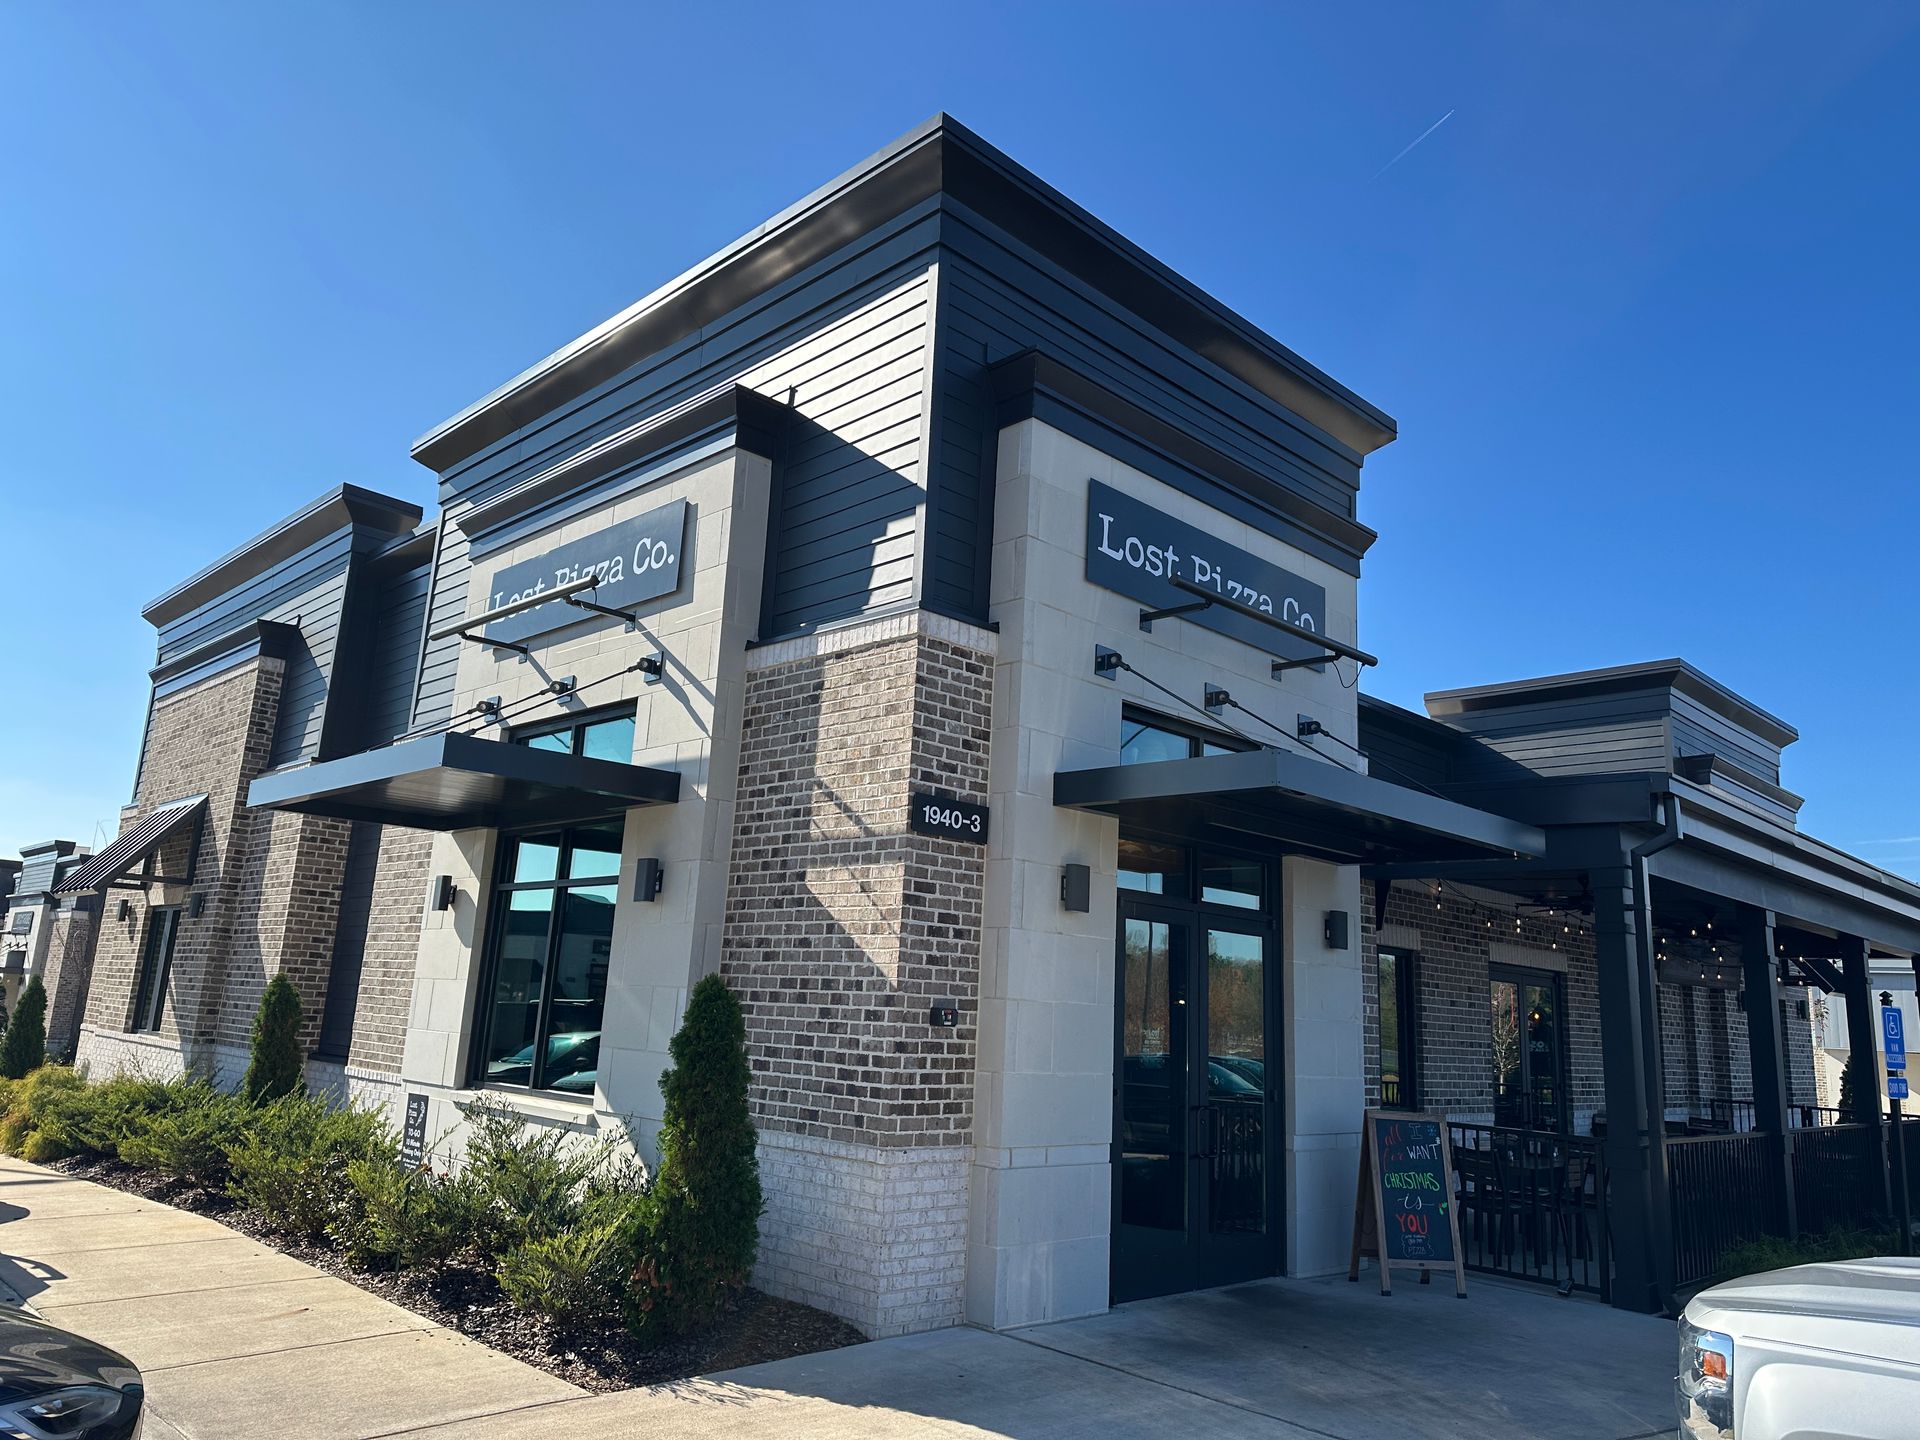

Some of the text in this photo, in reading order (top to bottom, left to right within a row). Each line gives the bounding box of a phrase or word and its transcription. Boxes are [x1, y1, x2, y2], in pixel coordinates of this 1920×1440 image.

[554, 555, 625, 603] Pizza
[632, 537, 675, 575] Co.
[1097, 512, 1181, 580] Lost
[1190, 554, 1273, 615] Pizza
[922, 805, 981, 833] 1940-3
[1408, 1122, 1424, 1140] I
[1406, 1143, 1439, 1160] WANT
[1384, 1172, 1440, 1192] CHRISTMAS
[1395, 1213, 1429, 1235] YOU
